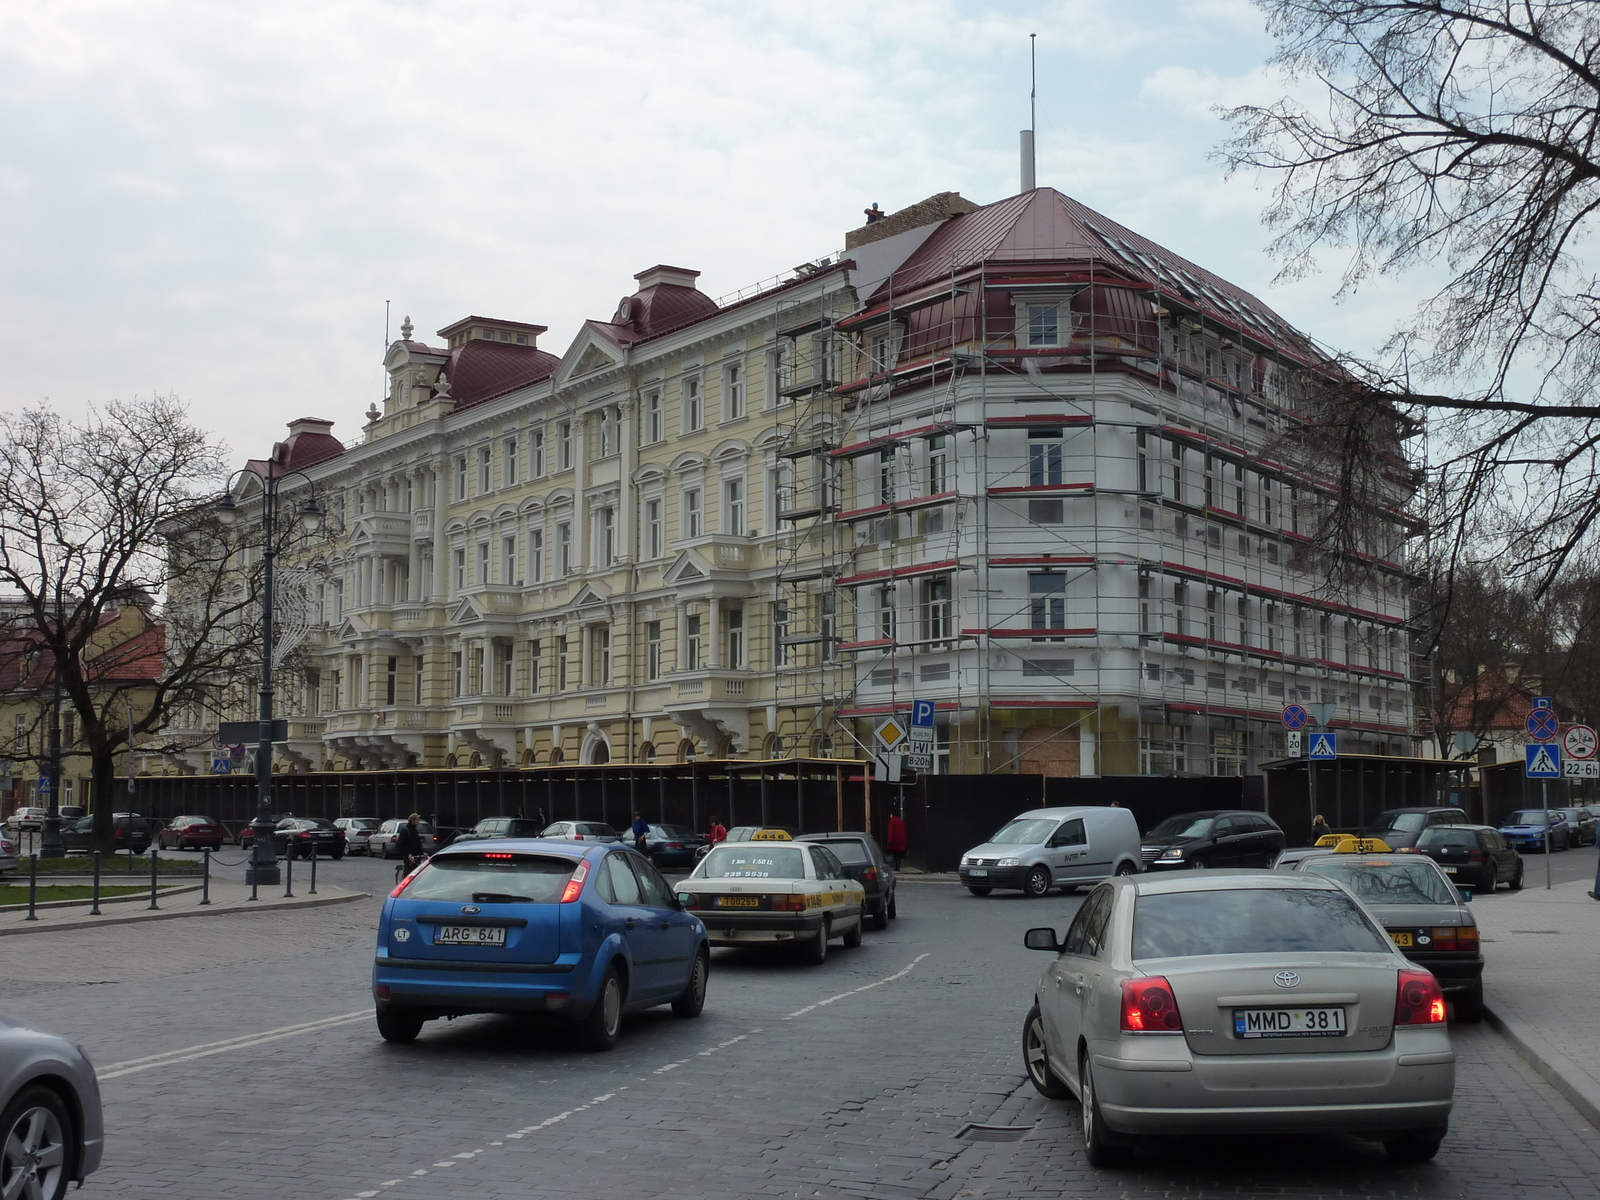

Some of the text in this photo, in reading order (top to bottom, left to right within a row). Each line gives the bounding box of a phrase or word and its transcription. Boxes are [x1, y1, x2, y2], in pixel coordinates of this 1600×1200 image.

[917, 702, 931, 724] P
[913, 741, 929, 754] I-VI
[1289, 740, 1300, 749] 20
[908, 756, 930, 766] 8-20h
[1566, 763, 1598, 775] 22-6h
[397, 930, 407, 938] LT
[442, 927, 502, 941] ARG 641
[1247, 1010, 1340, 1031] MMD 381
